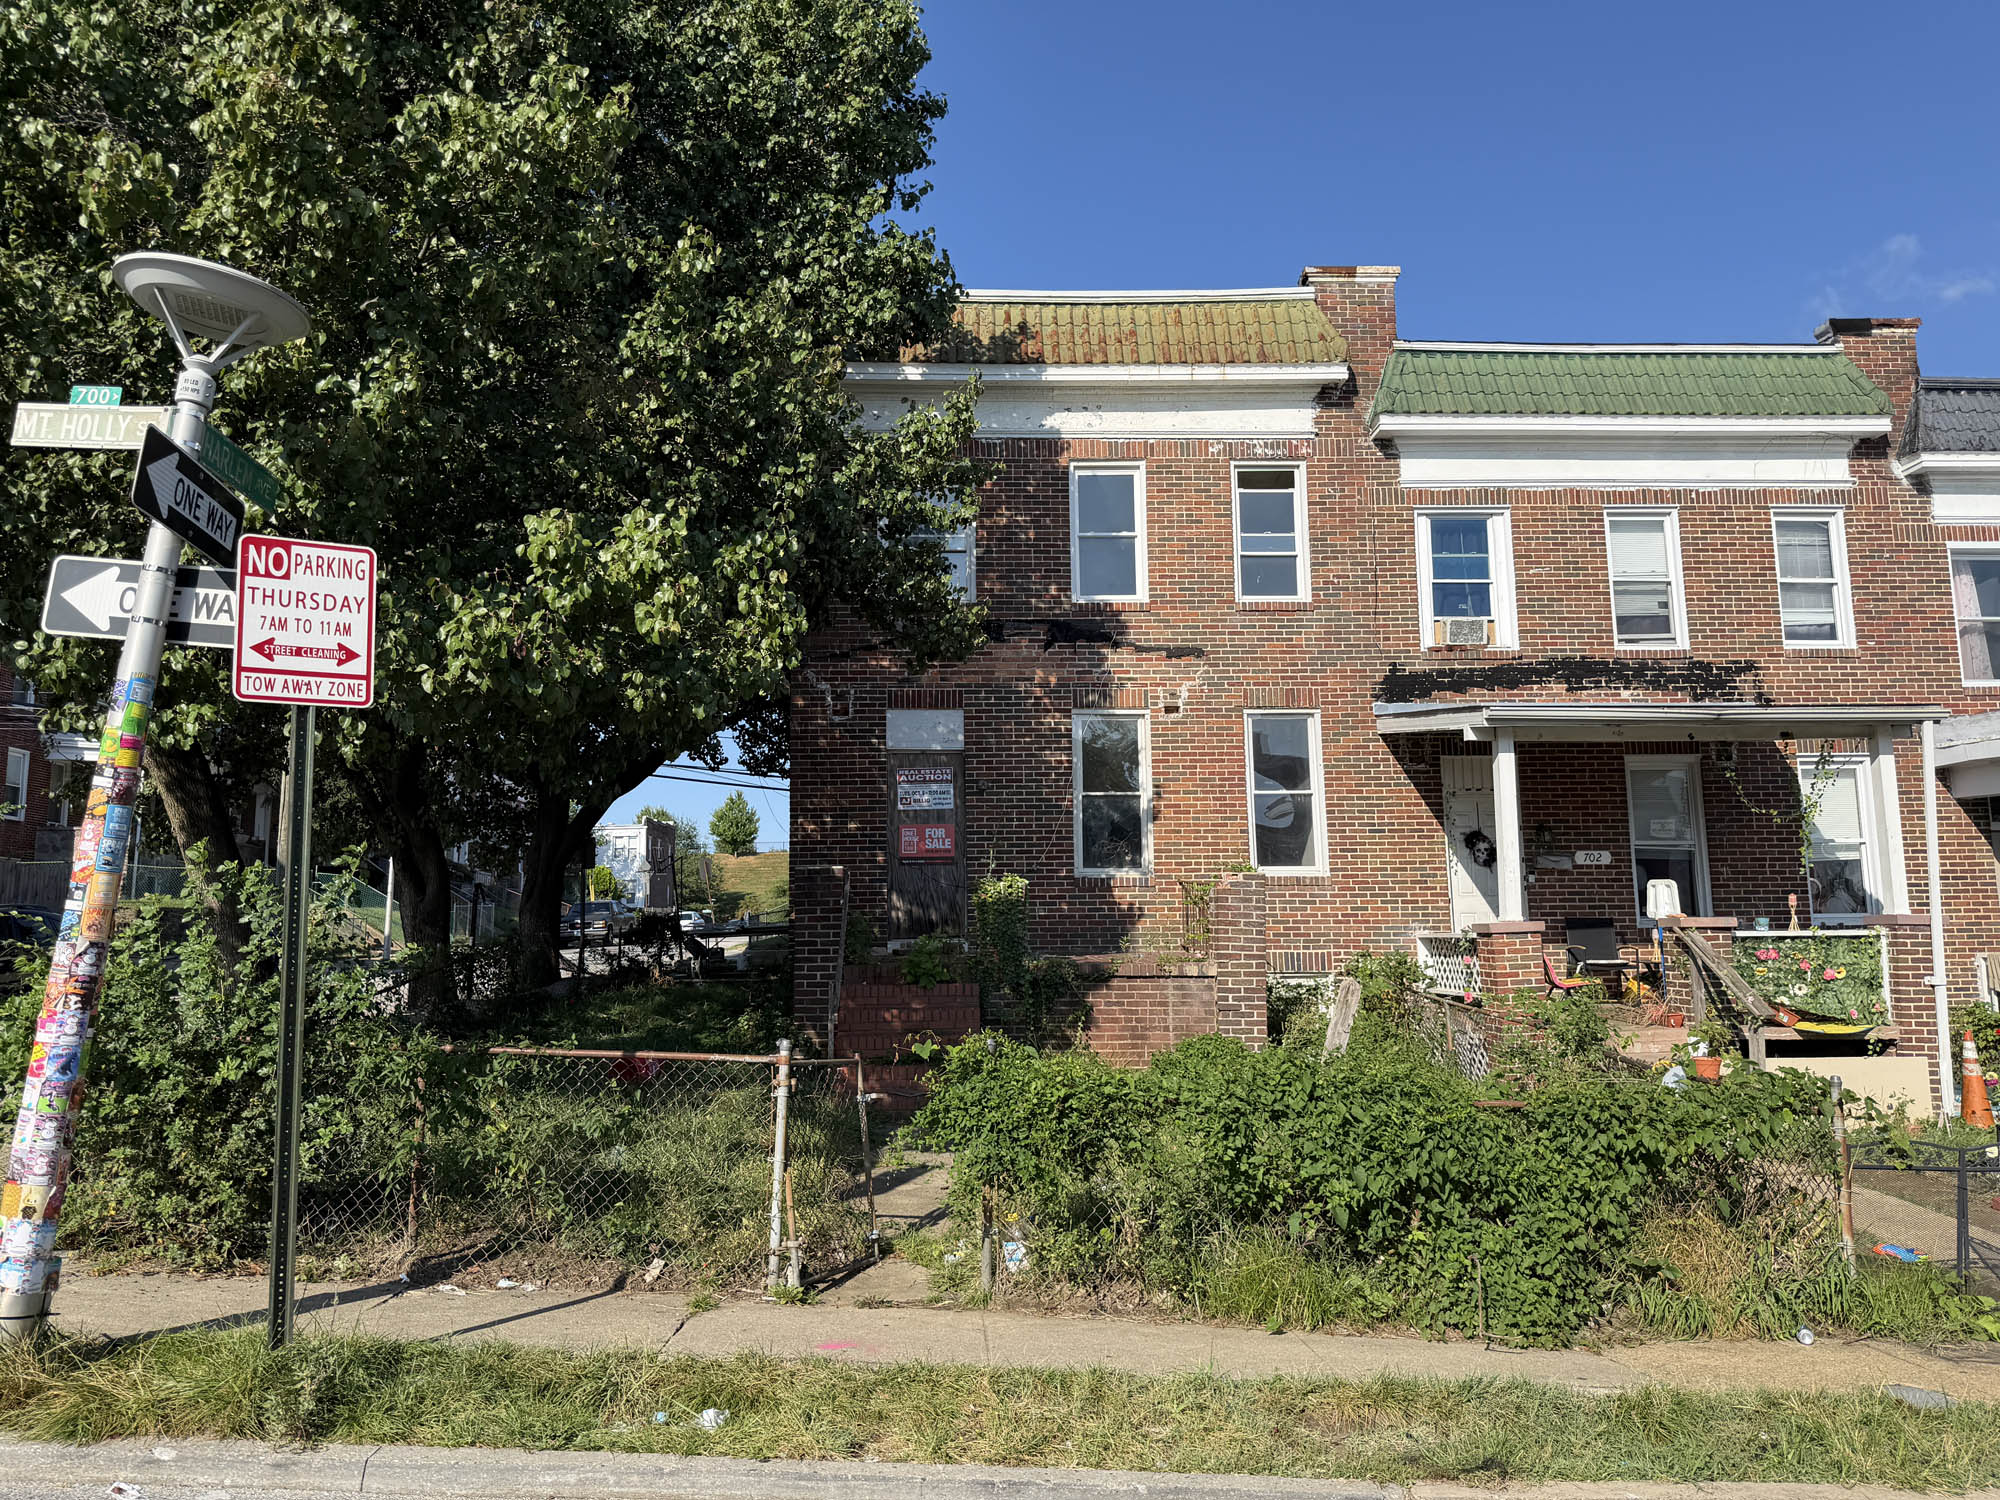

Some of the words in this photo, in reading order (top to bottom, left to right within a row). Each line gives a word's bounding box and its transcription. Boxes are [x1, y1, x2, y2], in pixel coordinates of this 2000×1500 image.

[75, 388, 110, 404] 700
[60, 413, 133, 442] HOLLY
[174, 477, 204, 521] ONE
[206, 501, 233, 542] WAY
[248, 544, 289, 577] NO
[294, 553, 366, 581] PARKING
[195, 591, 235, 622] WA
[247, 586, 366, 614] THURSDAY
[294, 617, 312, 633] TO
[264, 644, 297, 656] STREET
[301, 647, 347, 660] CLEANING
[244, 675, 276, 693] TOW
[281, 678, 322, 695] AWAY
[327, 681, 364, 698] ZONE
[925, 828, 945, 838] FOR
[925, 838, 951, 849] SALE
[1583, 852, 1602, 863] 702
